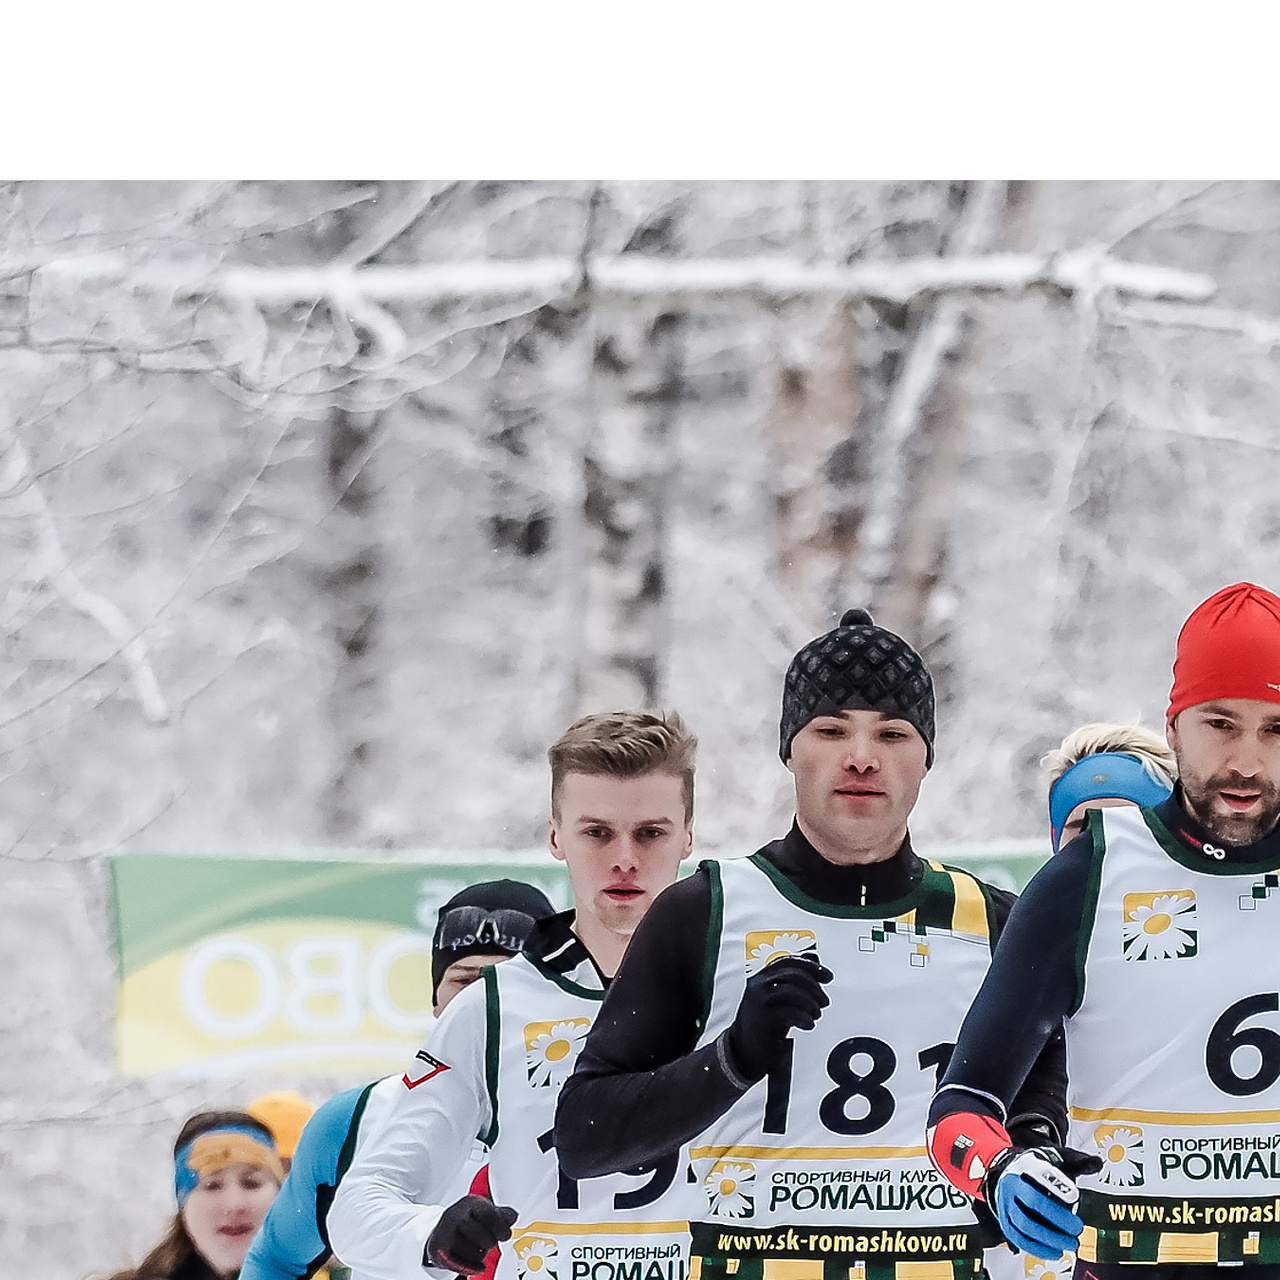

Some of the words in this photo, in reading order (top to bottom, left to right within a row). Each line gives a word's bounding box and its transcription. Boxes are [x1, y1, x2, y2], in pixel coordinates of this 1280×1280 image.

[771, 1168, 892, 1186] СПОРТИВНЫЙ
[899, 1168, 938, 1183] КЛУБ
[718, 1228, 968, 1252] www.sk-romashkovo.ru
[571, 1243, 682, 1261] СПОРТИВНЫЙ
